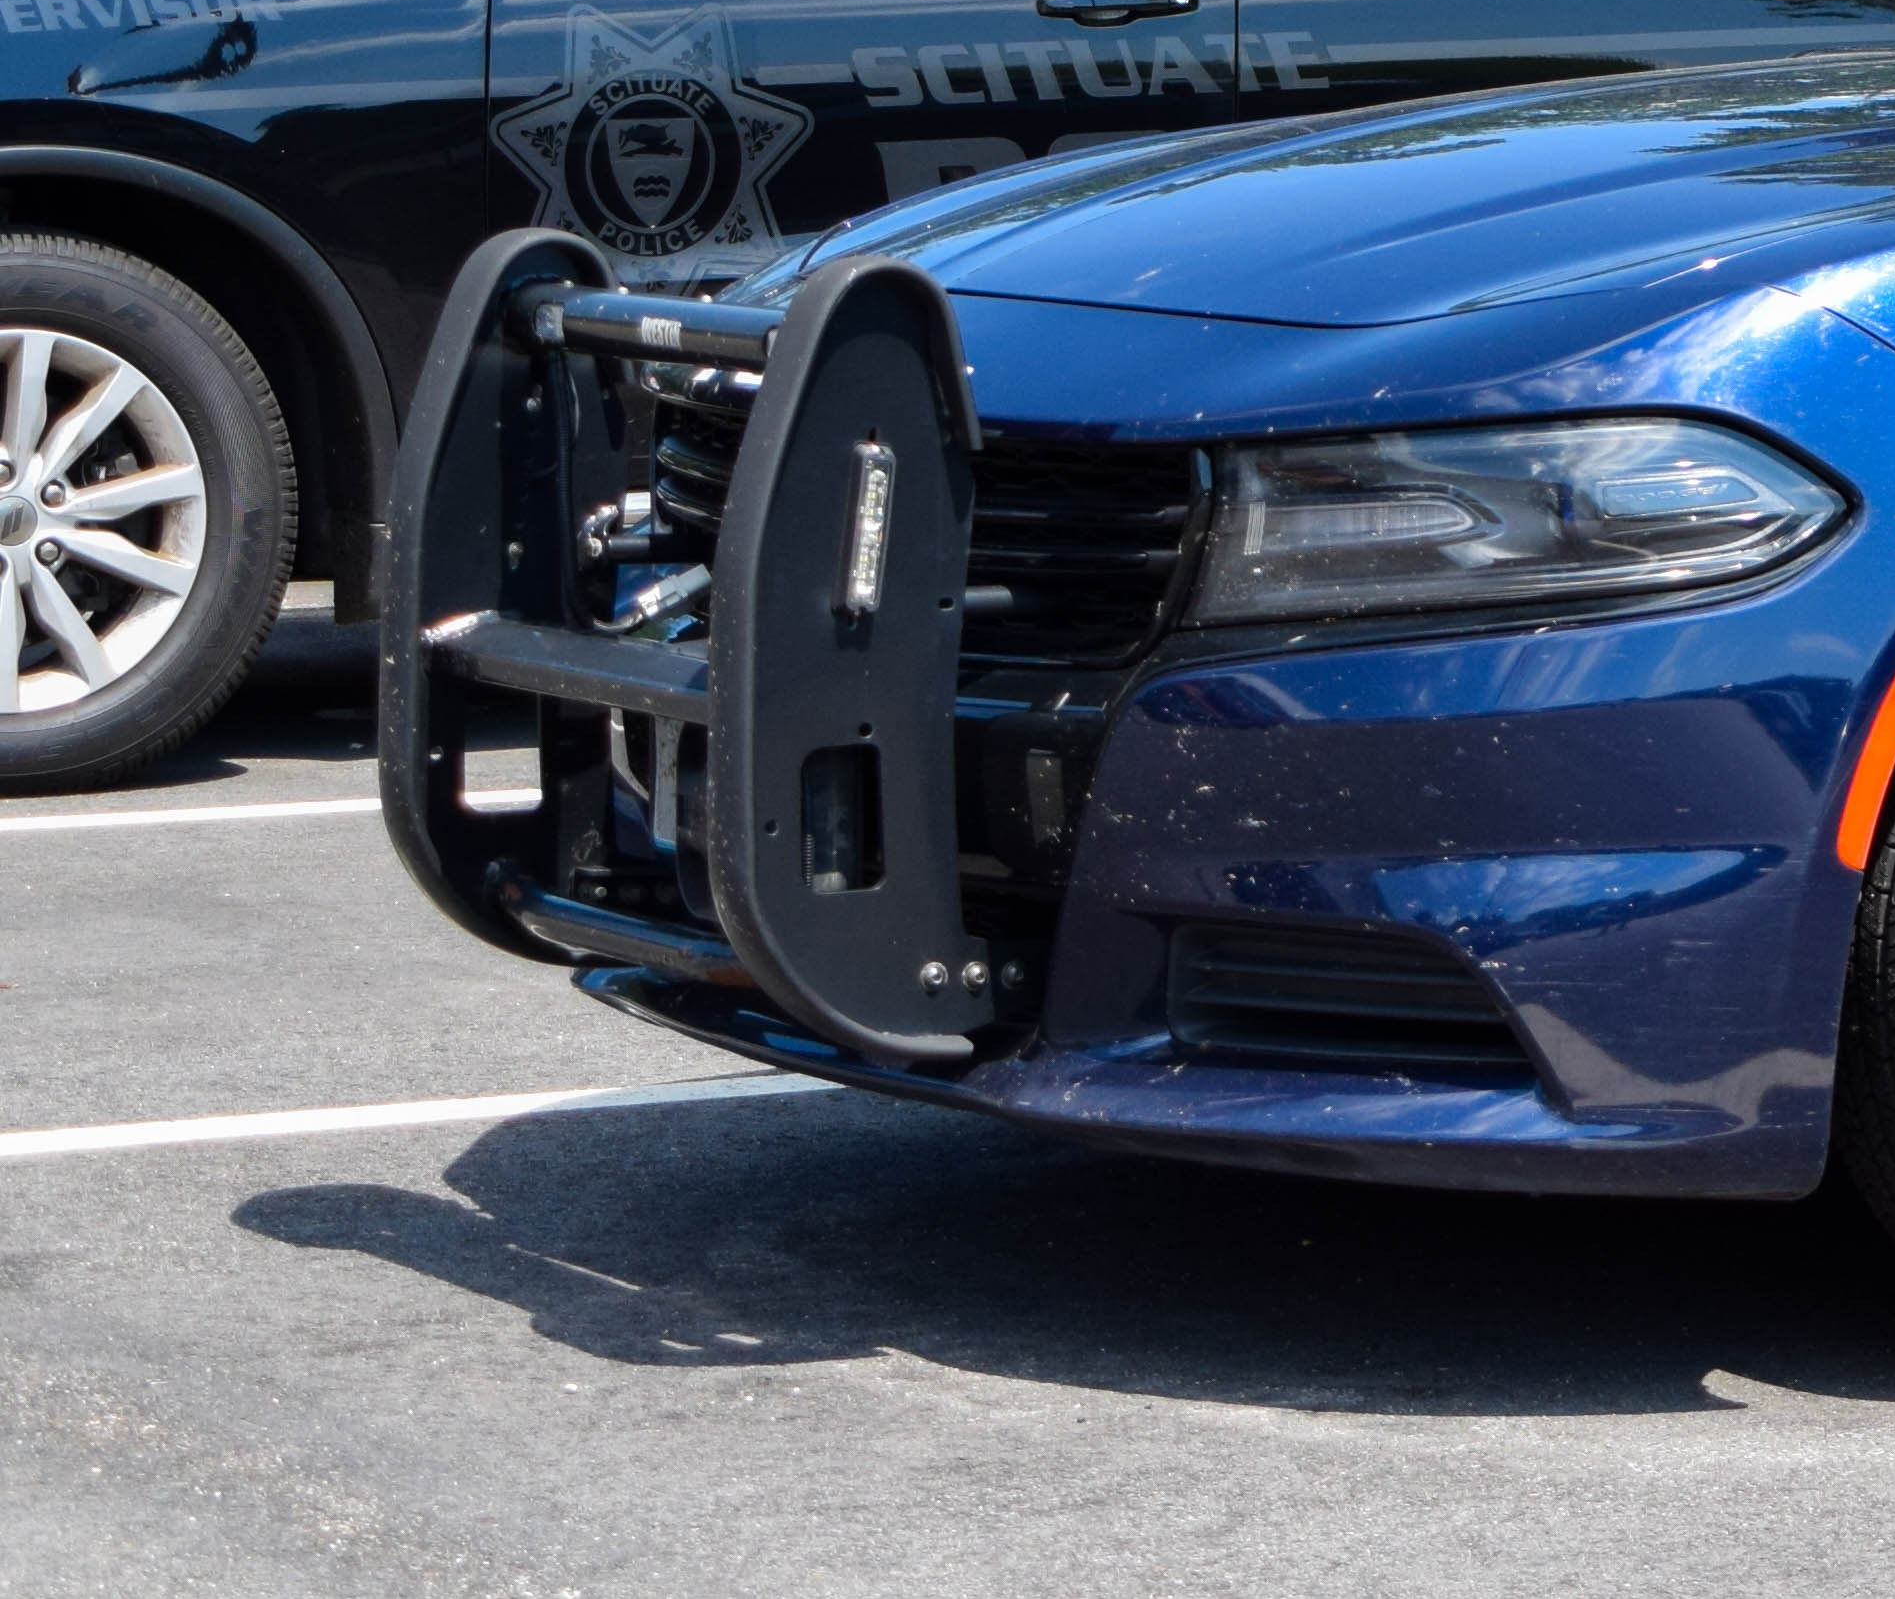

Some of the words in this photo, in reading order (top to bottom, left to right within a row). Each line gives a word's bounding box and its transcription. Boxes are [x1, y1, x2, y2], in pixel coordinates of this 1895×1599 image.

[851, 31, 1330, 107] SCITUATE
[588, 73, 716, 116] SCITUATE
[598, 216, 705, 257] POLICE
